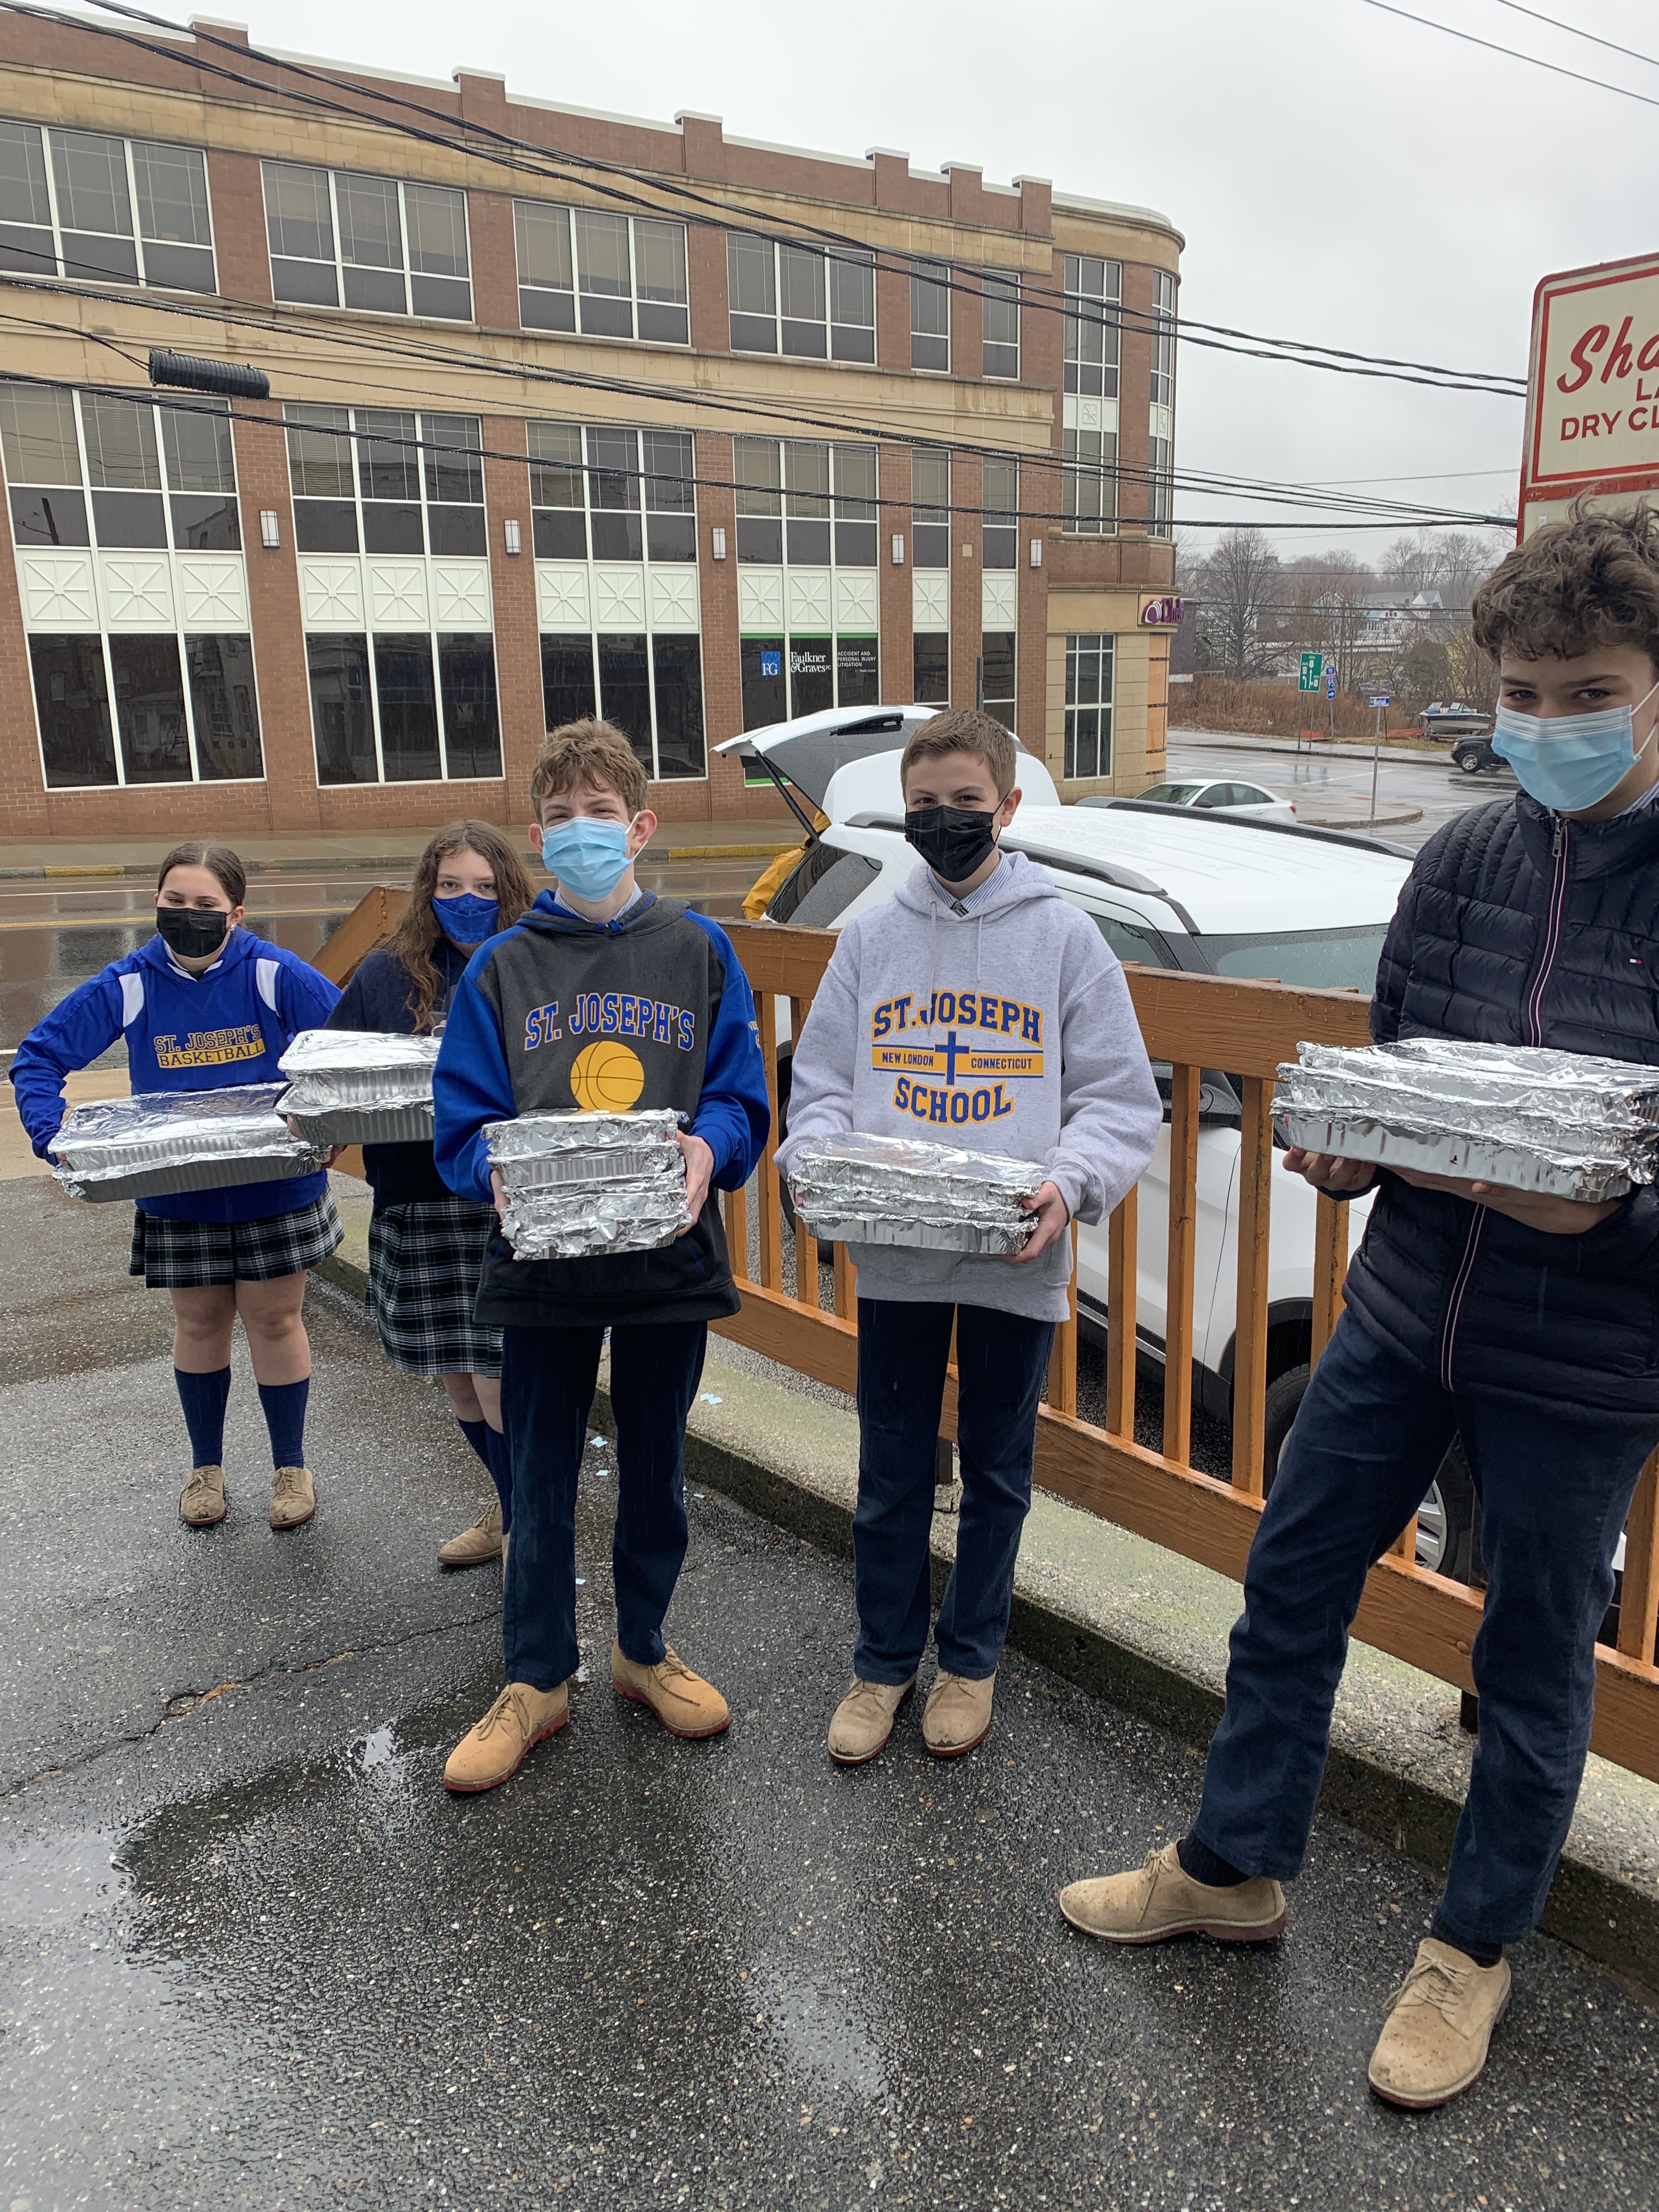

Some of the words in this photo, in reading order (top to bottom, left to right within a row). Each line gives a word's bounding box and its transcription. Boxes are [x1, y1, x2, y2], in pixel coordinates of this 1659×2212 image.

[1560, 410, 1622, 441] DRY
[761, 663, 778, 676] FG
[791, 652, 826, 663] Faulkner
[525, 1001, 562, 1052] ST.
[568, 992, 695, 1052] JOSEPH'S
[872, 993, 917, 1040] ST.
[918, 990, 1042, 1047] JOSEPH
[154, 1035, 181, 1053] ST.
[185, 1024, 261, 1050] JOSEPH'S
[159, 1043, 263, 1066] BASKETBALL
[882, 1052, 901, 1063] NEW
[903, 1054, 934, 1066] LONDON
[971, 1058, 1032, 1070] CONNECTICUT
[894, 1076, 1012, 1124] SCHOOL
